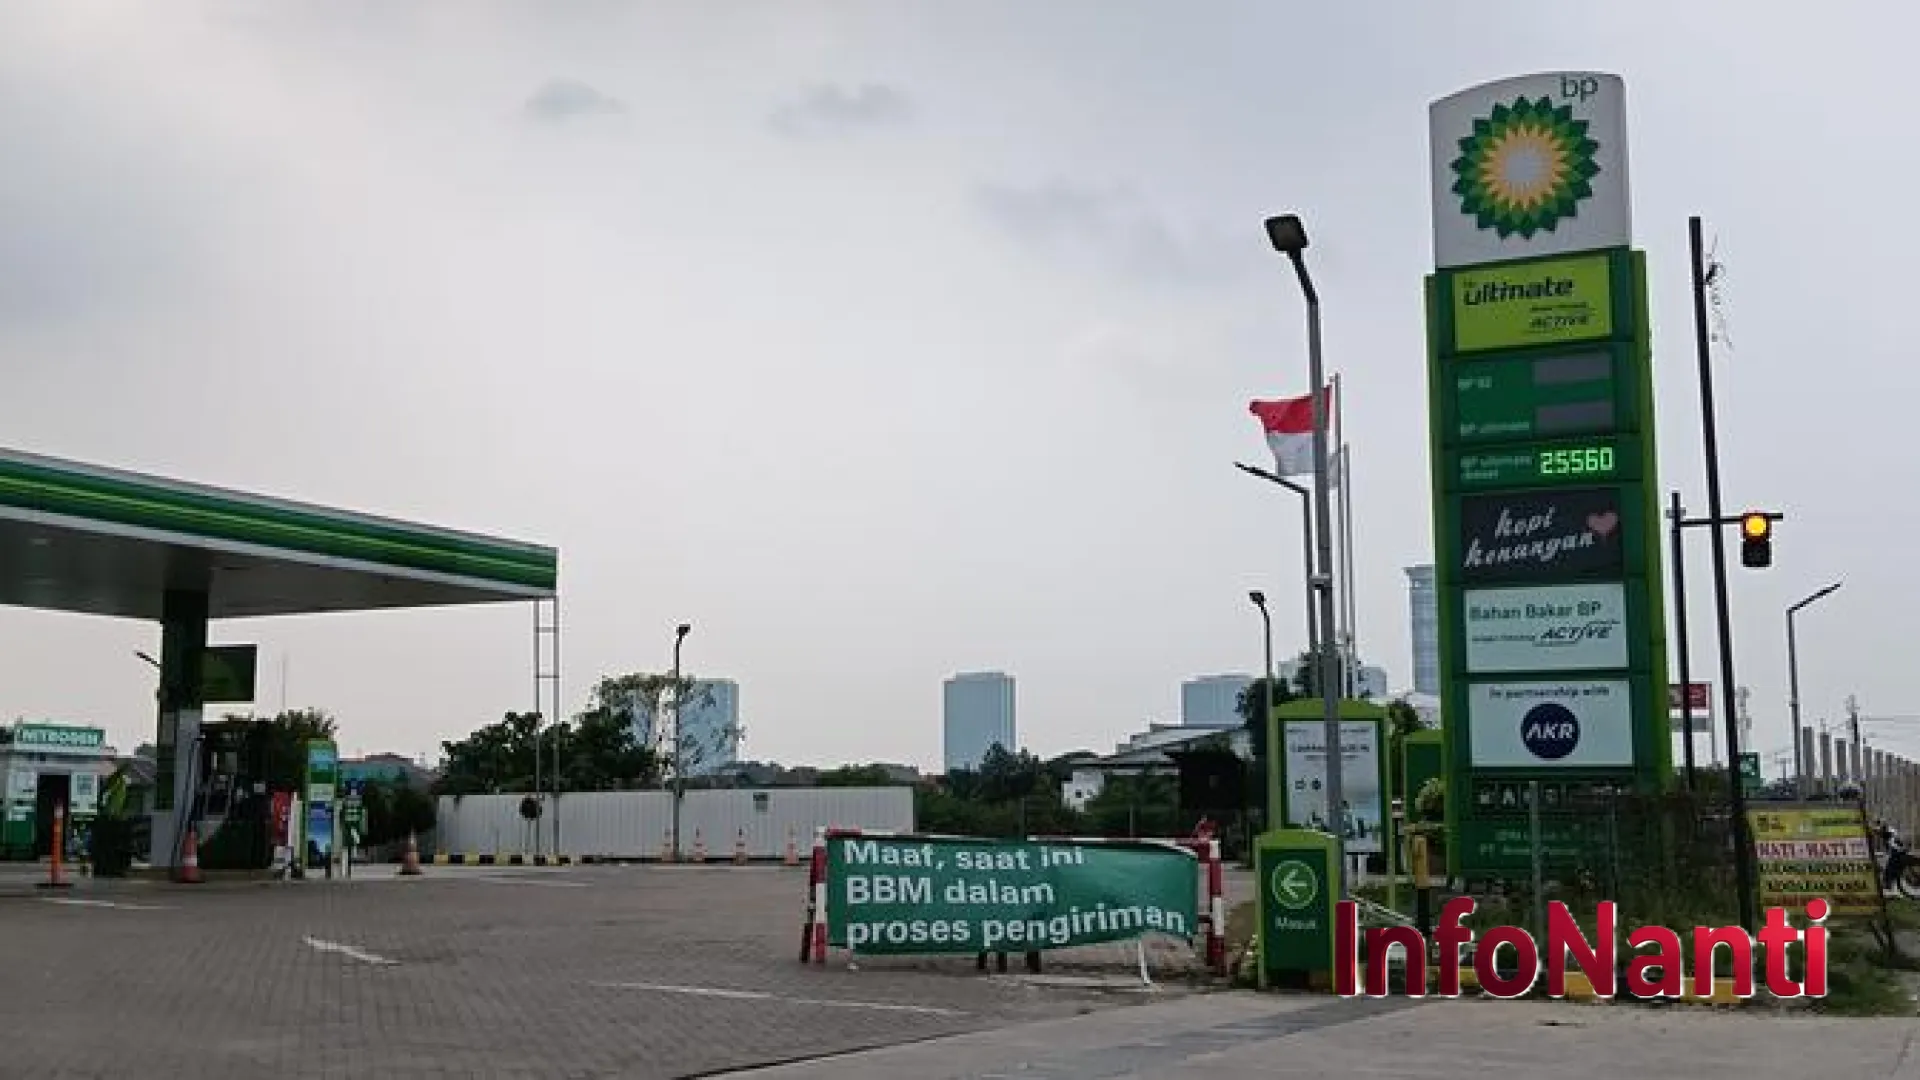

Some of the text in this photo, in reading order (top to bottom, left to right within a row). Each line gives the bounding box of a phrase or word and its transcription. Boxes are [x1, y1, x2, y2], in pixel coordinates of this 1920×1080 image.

[1561, 76, 1599, 103] bp
[1540, 446, 1613, 474] 25560
[1494, 505, 1556, 539] kopi
[1462, 532, 1595, 568] kenangan
[1469, 600, 1601, 621] Bahan Bakar BP
[1525, 721, 1573, 740] AKR
[844, 840, 1085, 870] Maaf, saat ini
[846, 875, 1055, 904] BBM dalam
[847, 919, 971, 950] proses
